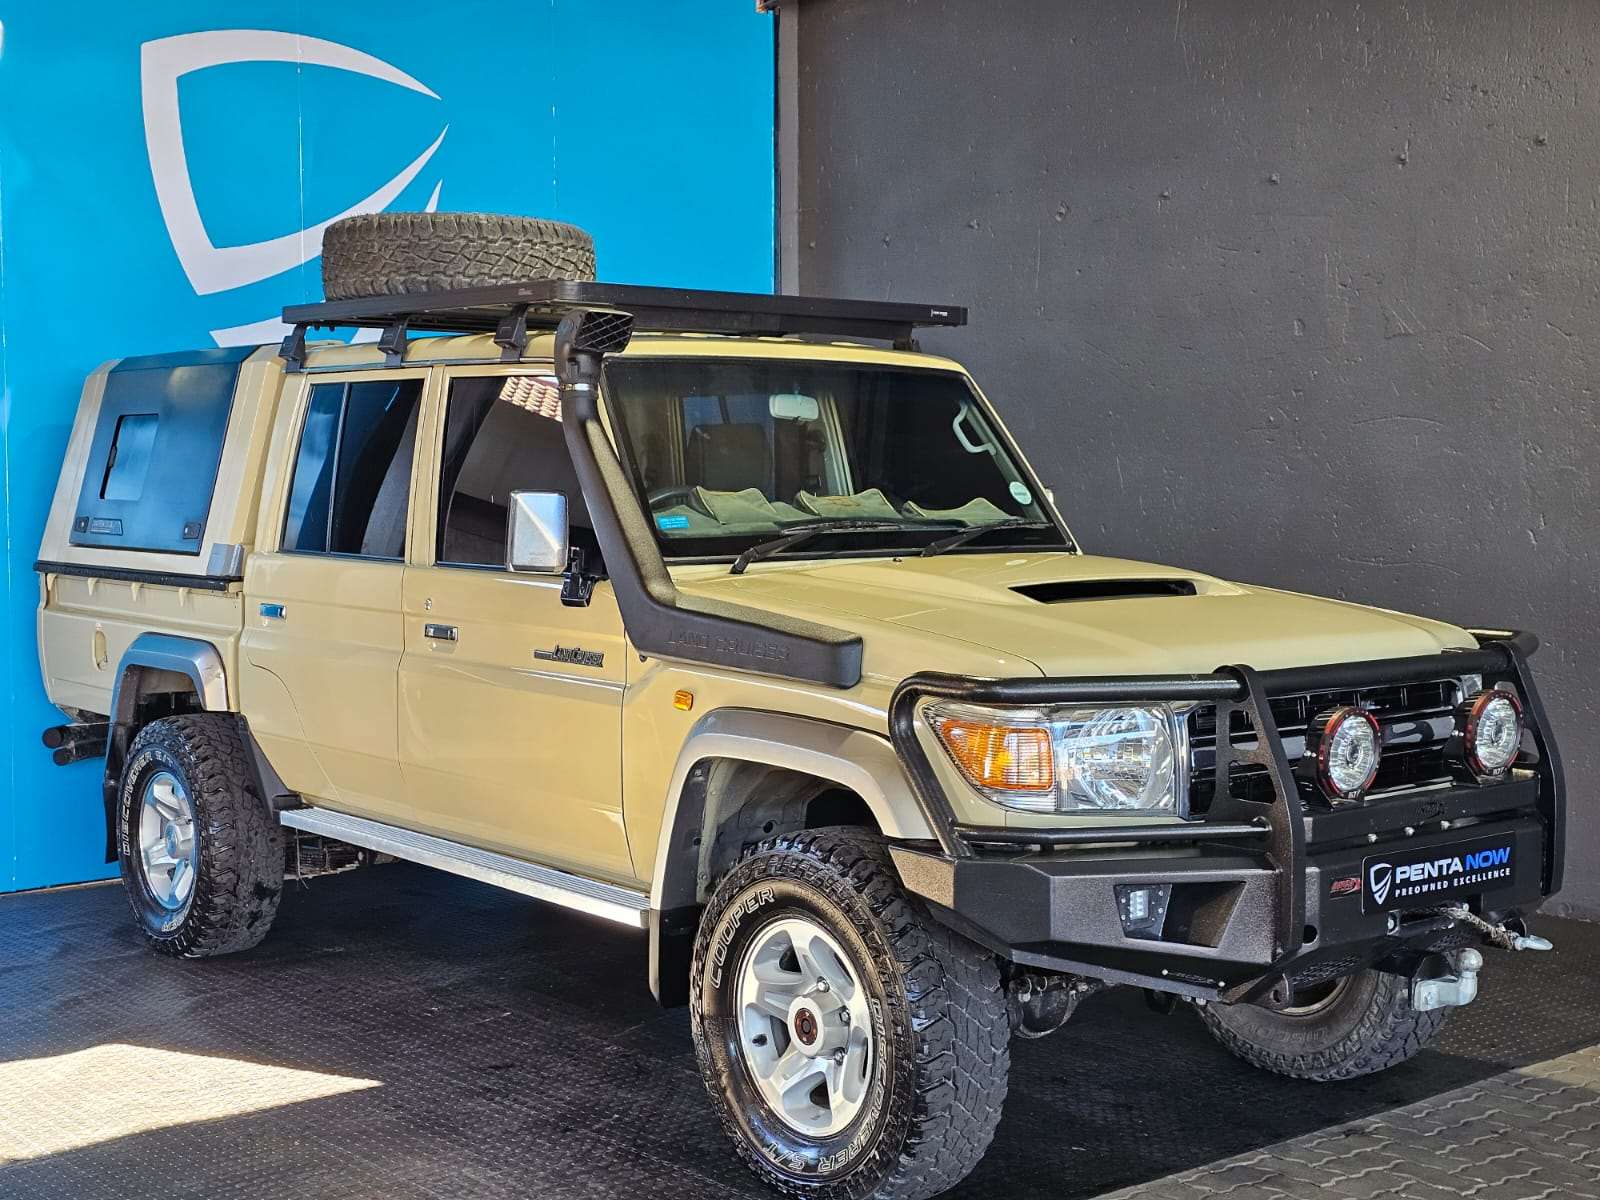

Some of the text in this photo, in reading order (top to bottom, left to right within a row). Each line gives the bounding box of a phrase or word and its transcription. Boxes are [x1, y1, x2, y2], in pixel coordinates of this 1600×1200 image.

[1395, 847, 1511, 884] PENTA NOW
[1395, 868, 1511, 898] PREOWNED EXCELLENCE
[709, 887, 774, 989] COOPER
